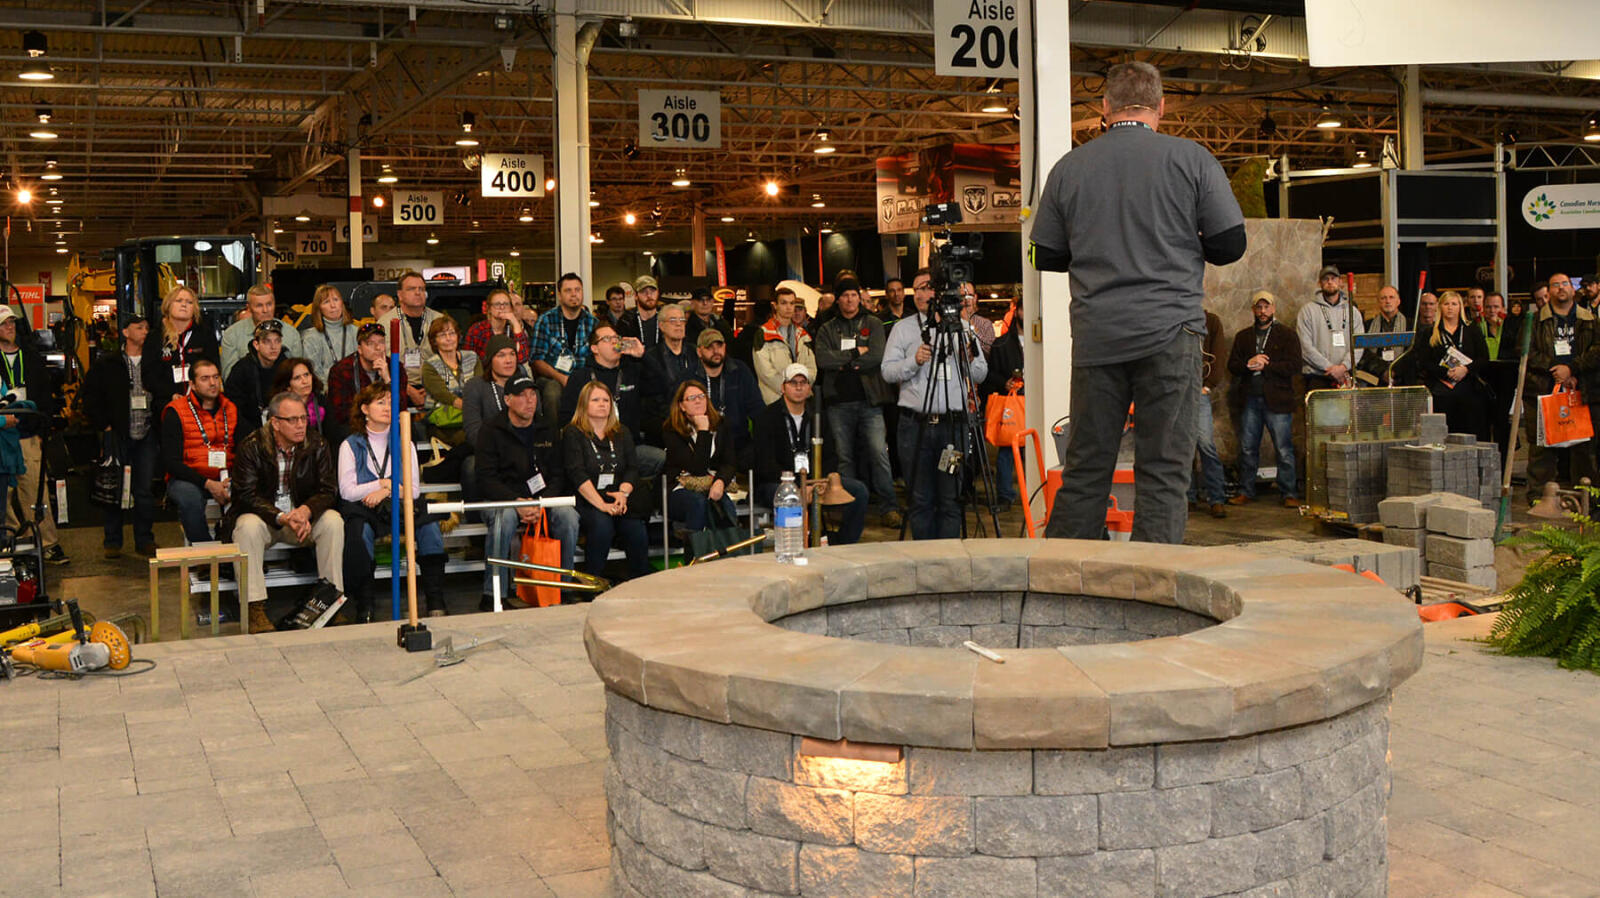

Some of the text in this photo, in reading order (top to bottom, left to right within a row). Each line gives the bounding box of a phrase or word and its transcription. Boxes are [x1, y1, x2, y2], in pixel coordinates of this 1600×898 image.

[968, 0, 1015, 20] Aisle
[664, 95, 697, 110] Aisle
[651, 112, 710, 142] 300
[501, 158, 526, 169] Aisle
[491, 171, 536, 192] 400
[407, 194, 429, 203] Aisle
[400, 204, 436, 221] 500
[301, 240, 327, 253] 700
[11, 291, 41, 301] STIHL
